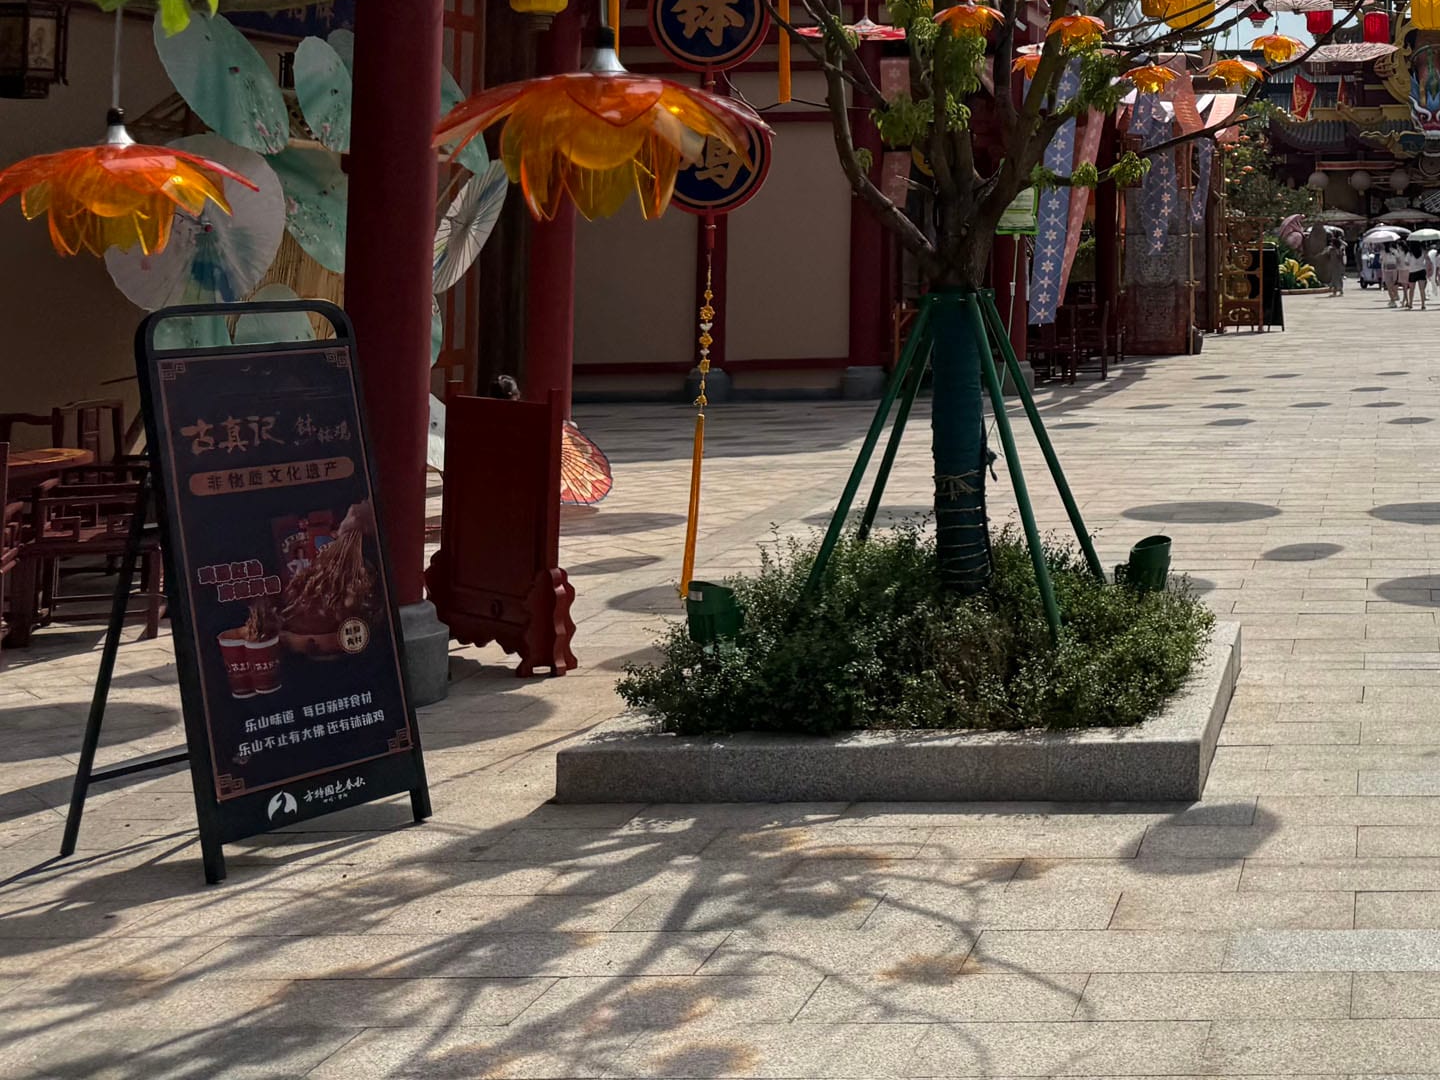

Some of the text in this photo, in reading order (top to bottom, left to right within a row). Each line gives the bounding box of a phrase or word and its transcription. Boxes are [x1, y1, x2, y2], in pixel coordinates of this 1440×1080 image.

[207, 461, 338, 491] 非物质文化遗产
[244, 691, 373, 734] 乐山味道 每日新鲜食材
[238, 725, 326, 757] 乐山不止有大佛
